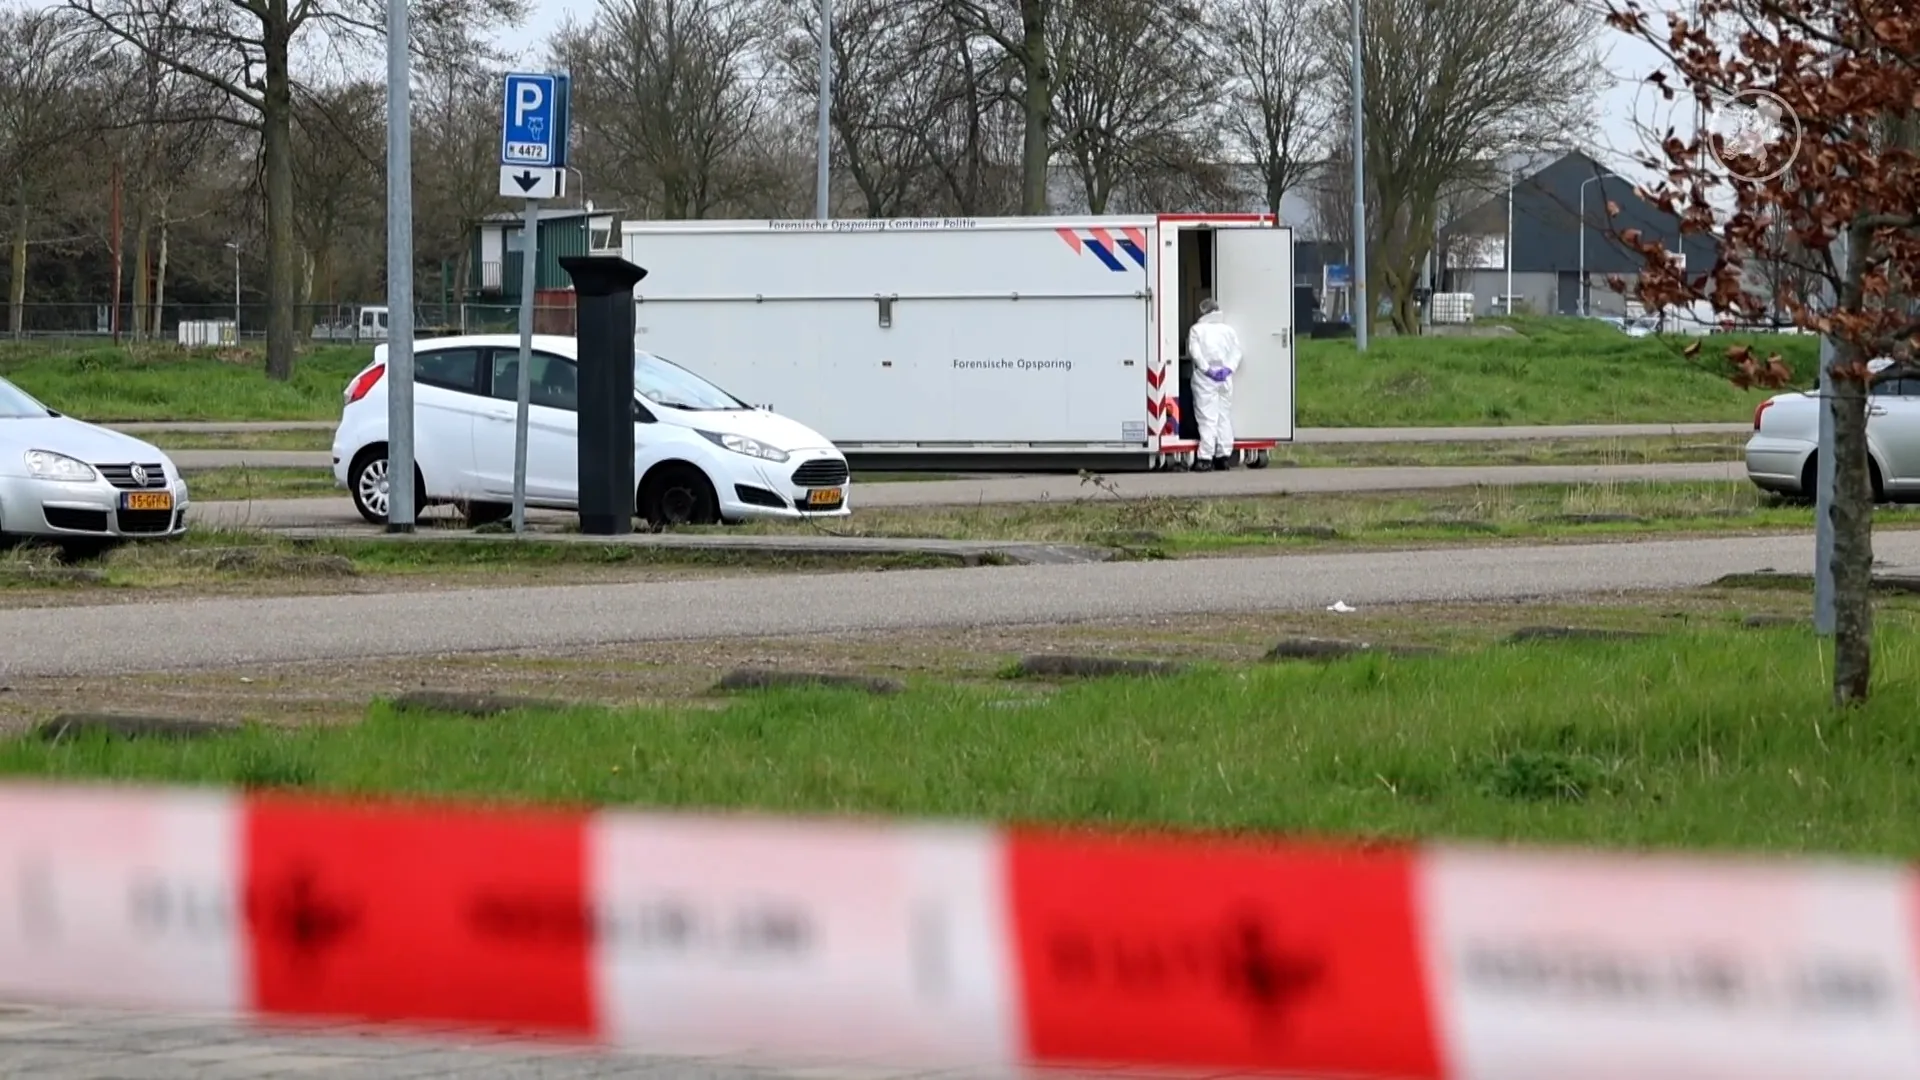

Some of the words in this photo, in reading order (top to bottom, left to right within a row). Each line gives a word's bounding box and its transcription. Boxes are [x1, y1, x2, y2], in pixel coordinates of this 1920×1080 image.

[515, 83, 543, 127] P
[518, 145, 543, 157] 4472
[769, 219, 828, 229] Forensische
[831, 219, 885, 231] Opsporing
[889, 219, 939, 228] Container
[943, 218, 976, 229] Politie
[953, 358, 1014, 369] Forensische
[1017, 359, 1072, 371] Opsporing
